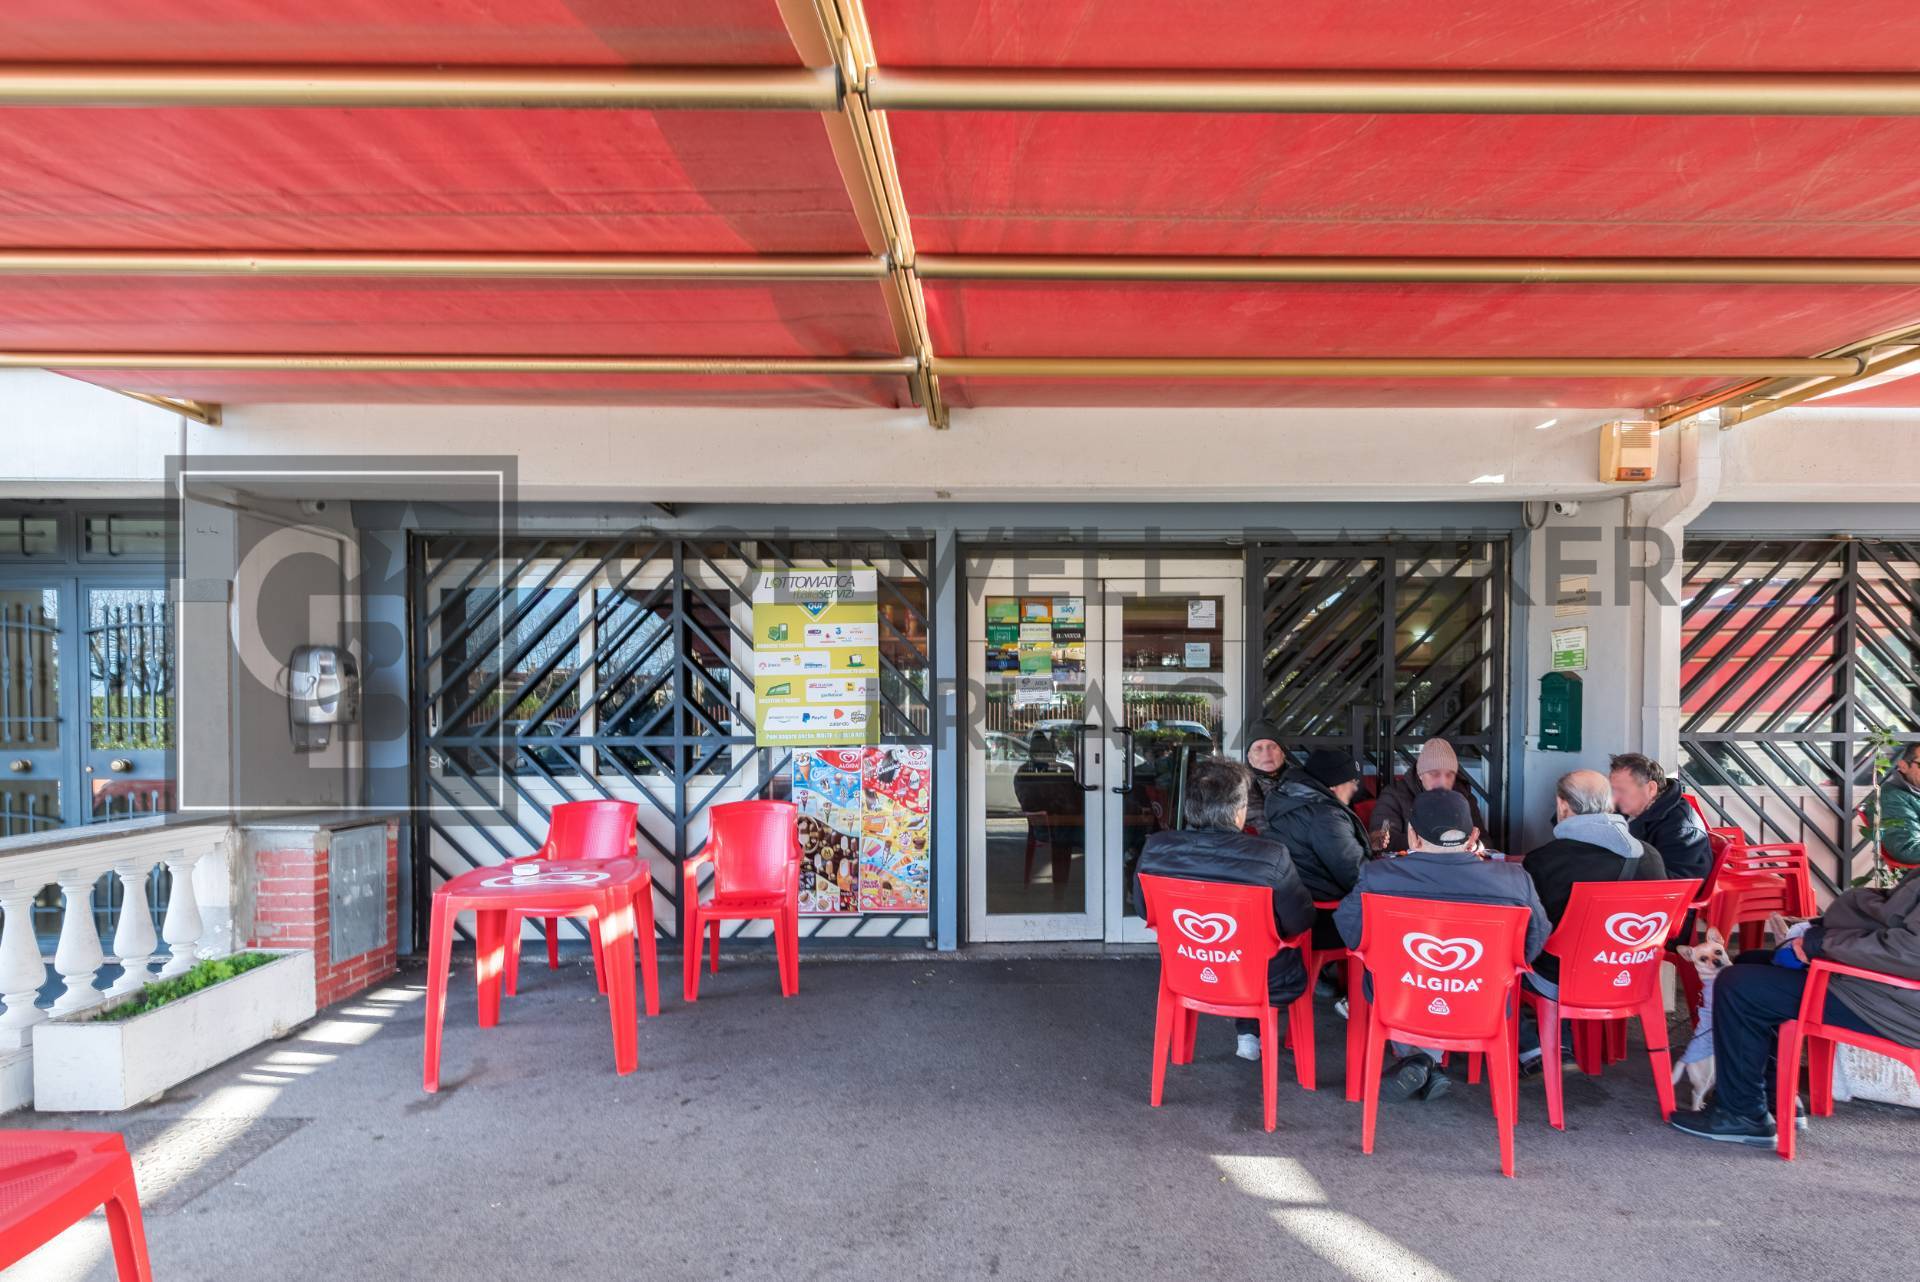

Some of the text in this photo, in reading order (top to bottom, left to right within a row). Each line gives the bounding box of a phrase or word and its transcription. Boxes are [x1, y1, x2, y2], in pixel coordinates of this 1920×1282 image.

[764, 575, 855, 589] LOTTOMATICA
[1060, 605, 1077, 615] sky
[1177, 943, 1241, 963] ALGIDA
[1593, 949, 1656, 965] ALGIDA
[1401, 971, 1480, 993] ALGIDA
